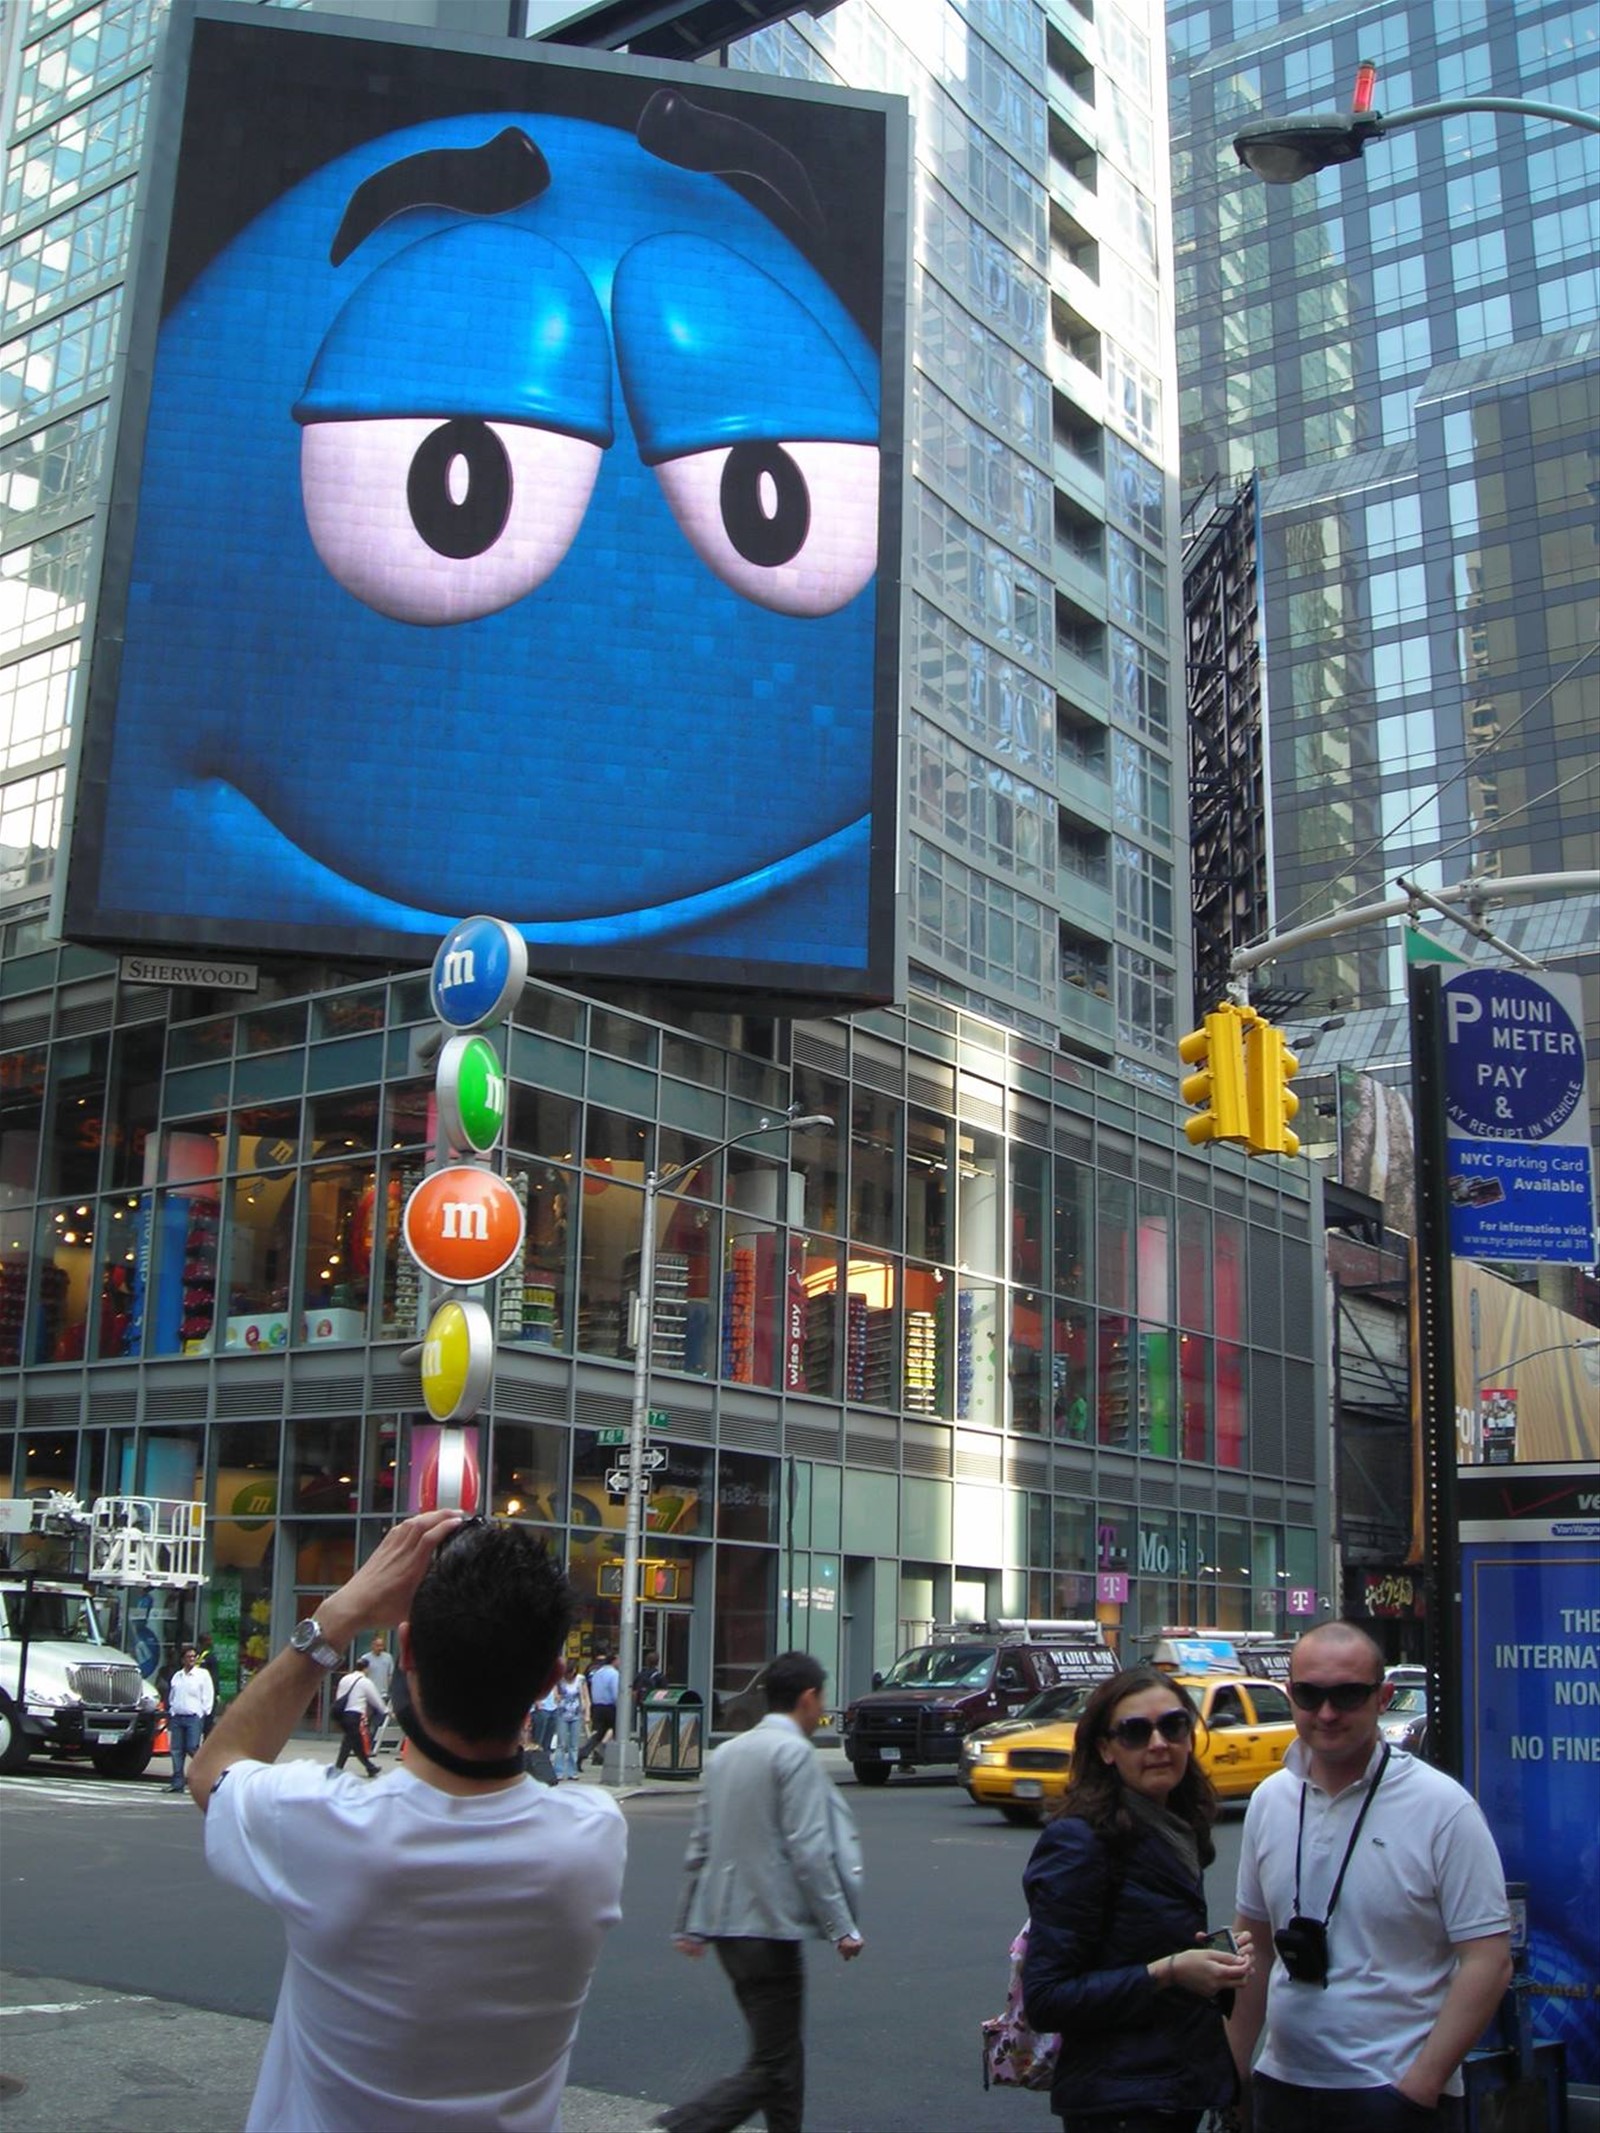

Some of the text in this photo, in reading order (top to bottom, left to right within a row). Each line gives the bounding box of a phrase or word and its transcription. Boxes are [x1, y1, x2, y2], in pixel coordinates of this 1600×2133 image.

[129, 959, 249, 986] SHERWOOD
[443, 949, 475, 988] m
[1447, 991, 1482, 1043] P
[1491, 997, 1551, 1023] MUNI
[1493, 1027, 1576, 1055] METER
[1478, 1064, 1527, 1089] PAY
[1469, 1118, 1523, 1139] RECEIPT
[1528, 1123, 1543, 1138] IN
[1544, 1080, 1581, 1128] VEHICLE
[1496, 1096, 1514, 1119] &
[1460, 1152, 1584, 1173] NYC Parking Card
[1513, 1178, 1585, 1193] Available
[441, 1202, 489, 1240] m
[1480, 1221, 1587, 1236] For information visit
[1556, 1239, 1573, 1249] call
[789, 1303, 802, 1387] wise guy
[1560, 1609, 1600, 1633] THE
[1496, 1645, 1600, 1669] INTERNA
[1511, 1736, 1600, 1762] NO FINE
